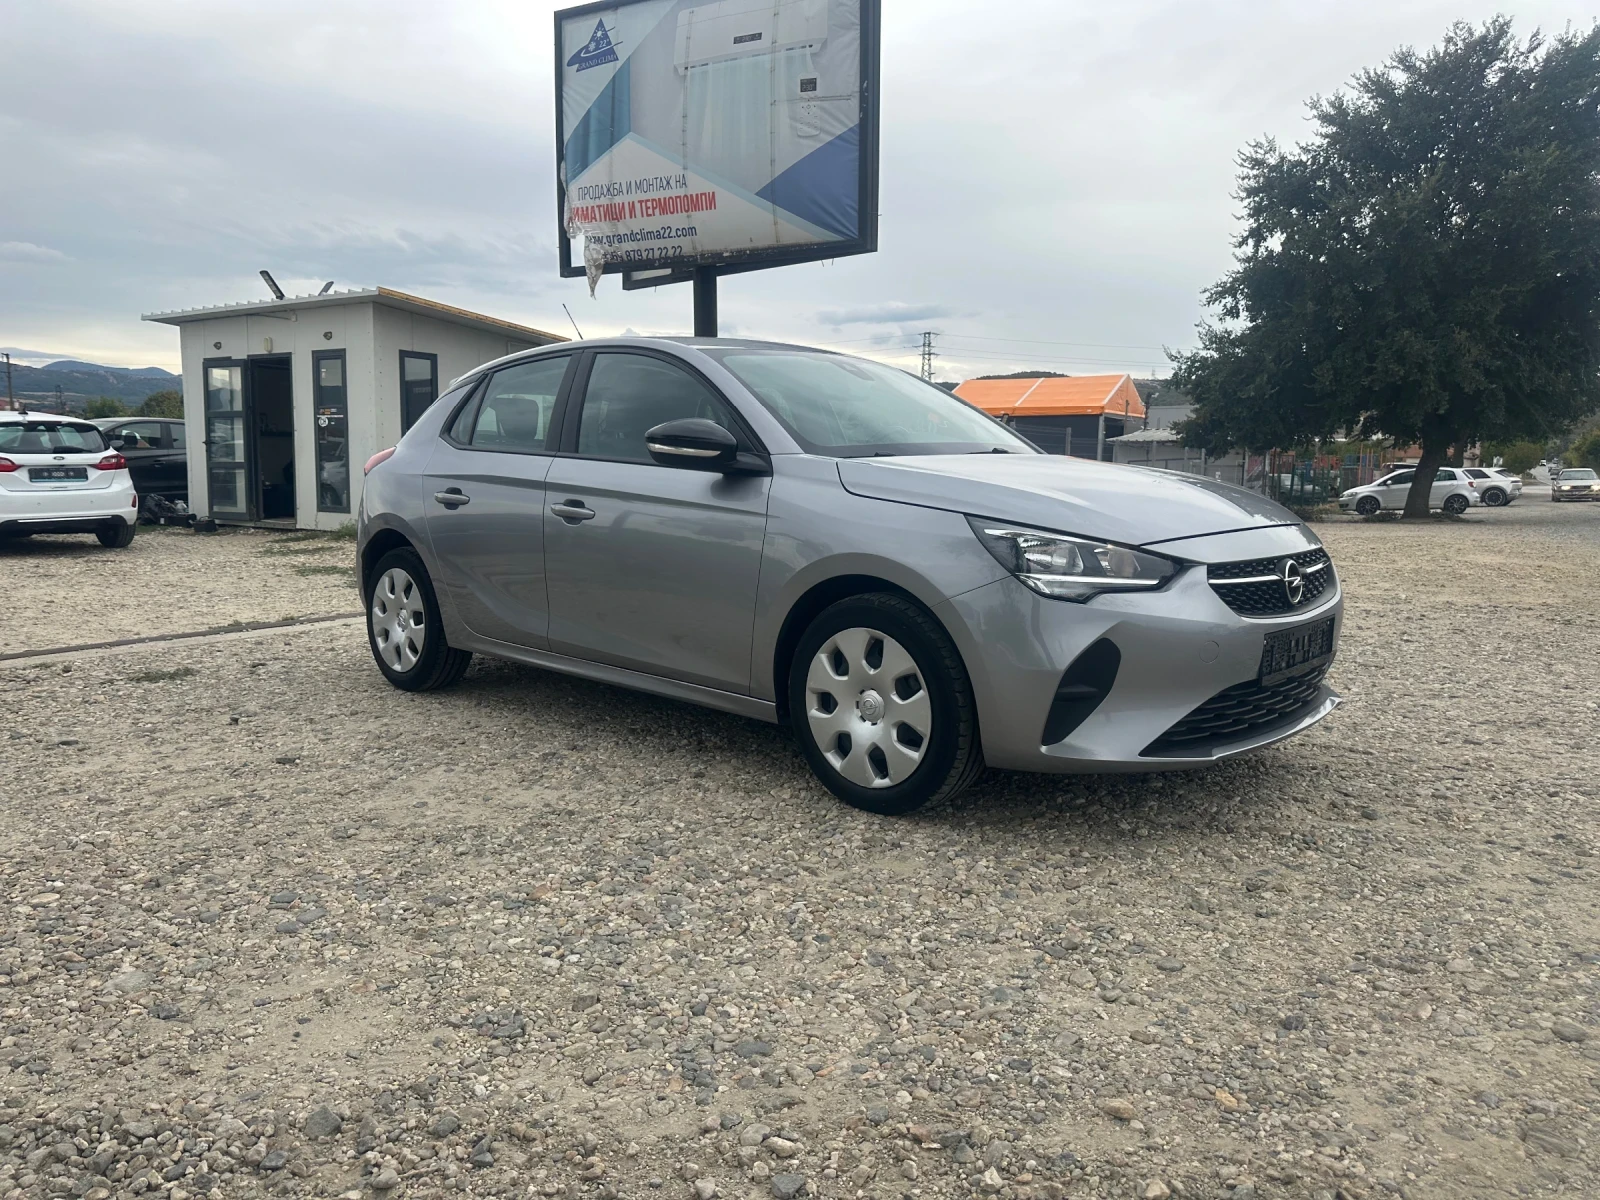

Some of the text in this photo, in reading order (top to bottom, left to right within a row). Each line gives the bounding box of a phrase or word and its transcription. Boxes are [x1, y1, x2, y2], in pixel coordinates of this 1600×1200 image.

[578, 54, 618, 69] GRAND CLIMA
[578, 173, 687, 201] ПРОДАЖБА И МОНТАЖ НА
[569, 191, 717, 223] ИМАТИЦИ И ТЕРМОПОМПИ
[625, 249, 643, 261] 879
[644, 247, 655, 260] 27
[658, 246, 669, 258] 22
[672, 245, 683, 257] 22
